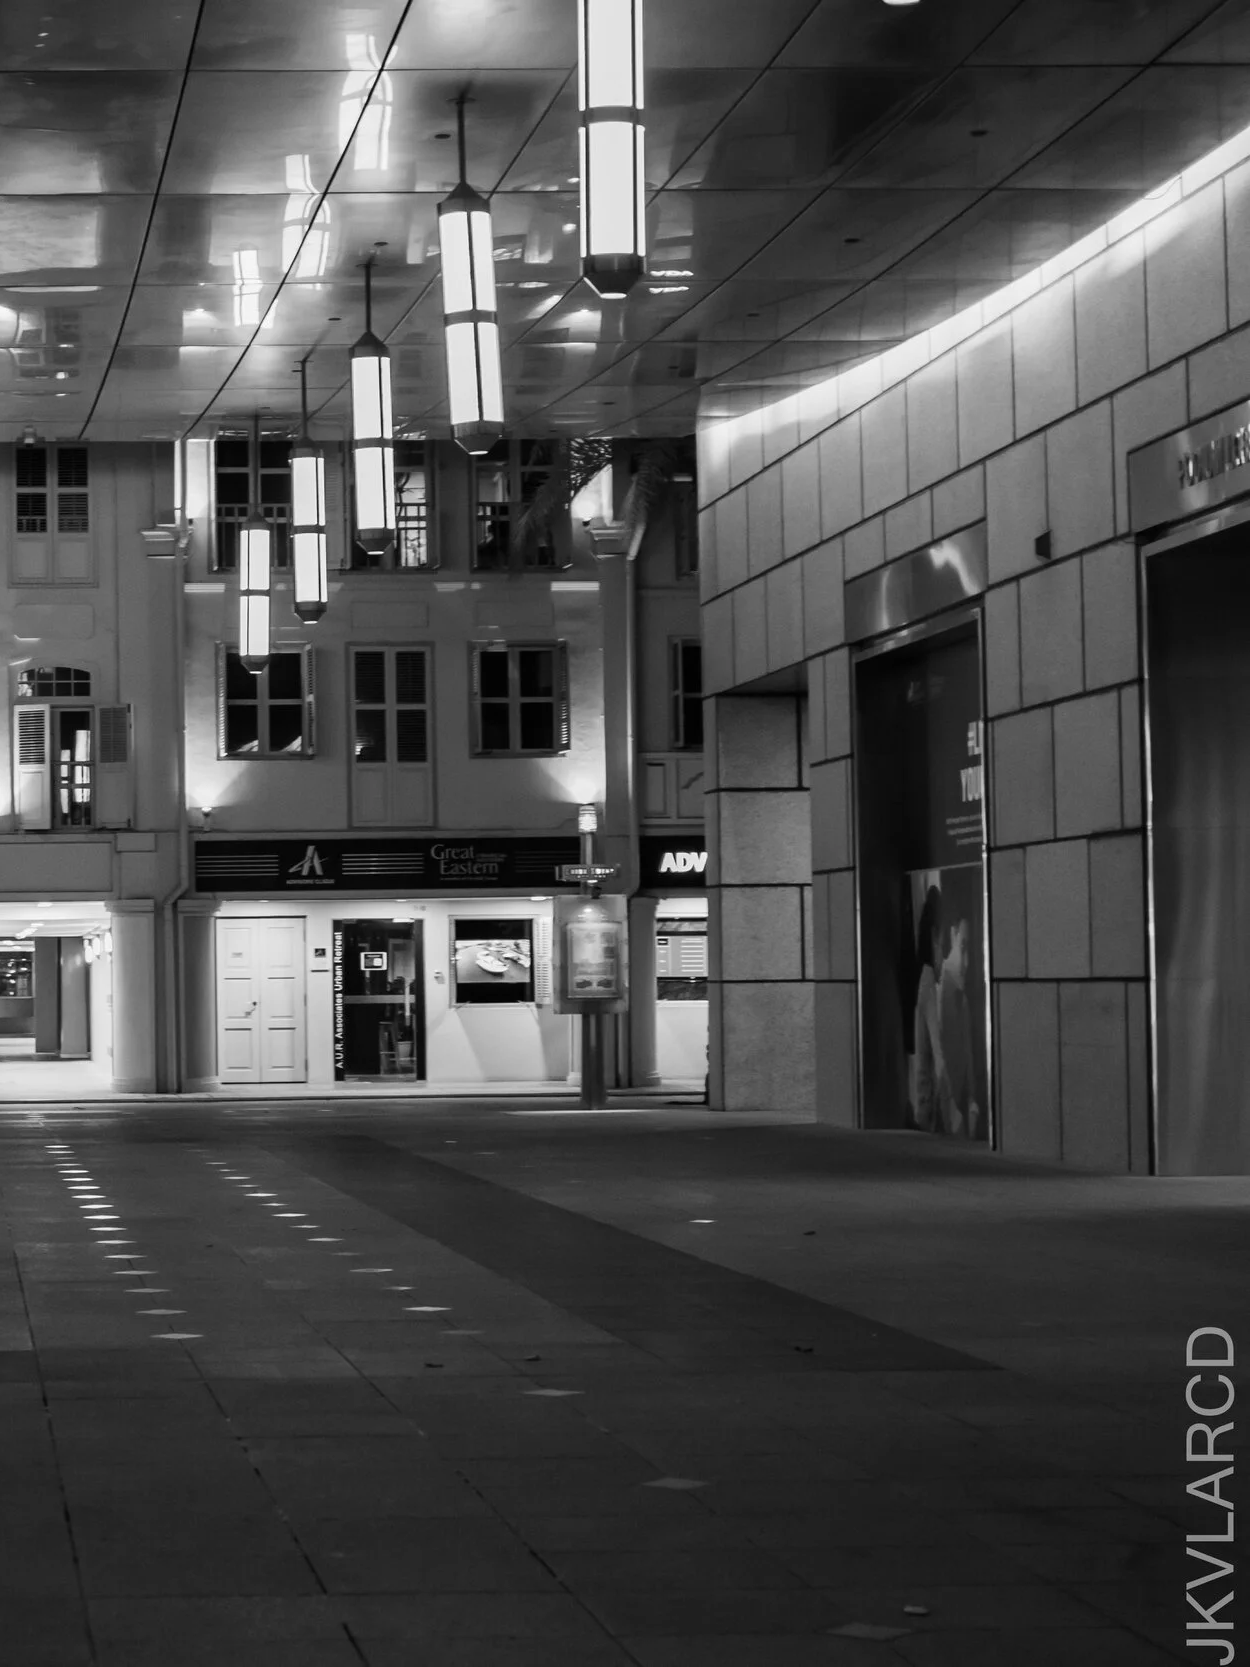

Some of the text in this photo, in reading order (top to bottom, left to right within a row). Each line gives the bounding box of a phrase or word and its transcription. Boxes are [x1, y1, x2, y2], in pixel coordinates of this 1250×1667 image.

[430, 844, 474, 860] Great
[440, 860, 499, 875] Eastern
[333, 932, 344, 1069] A.U.R. Associates Urban Retreat
